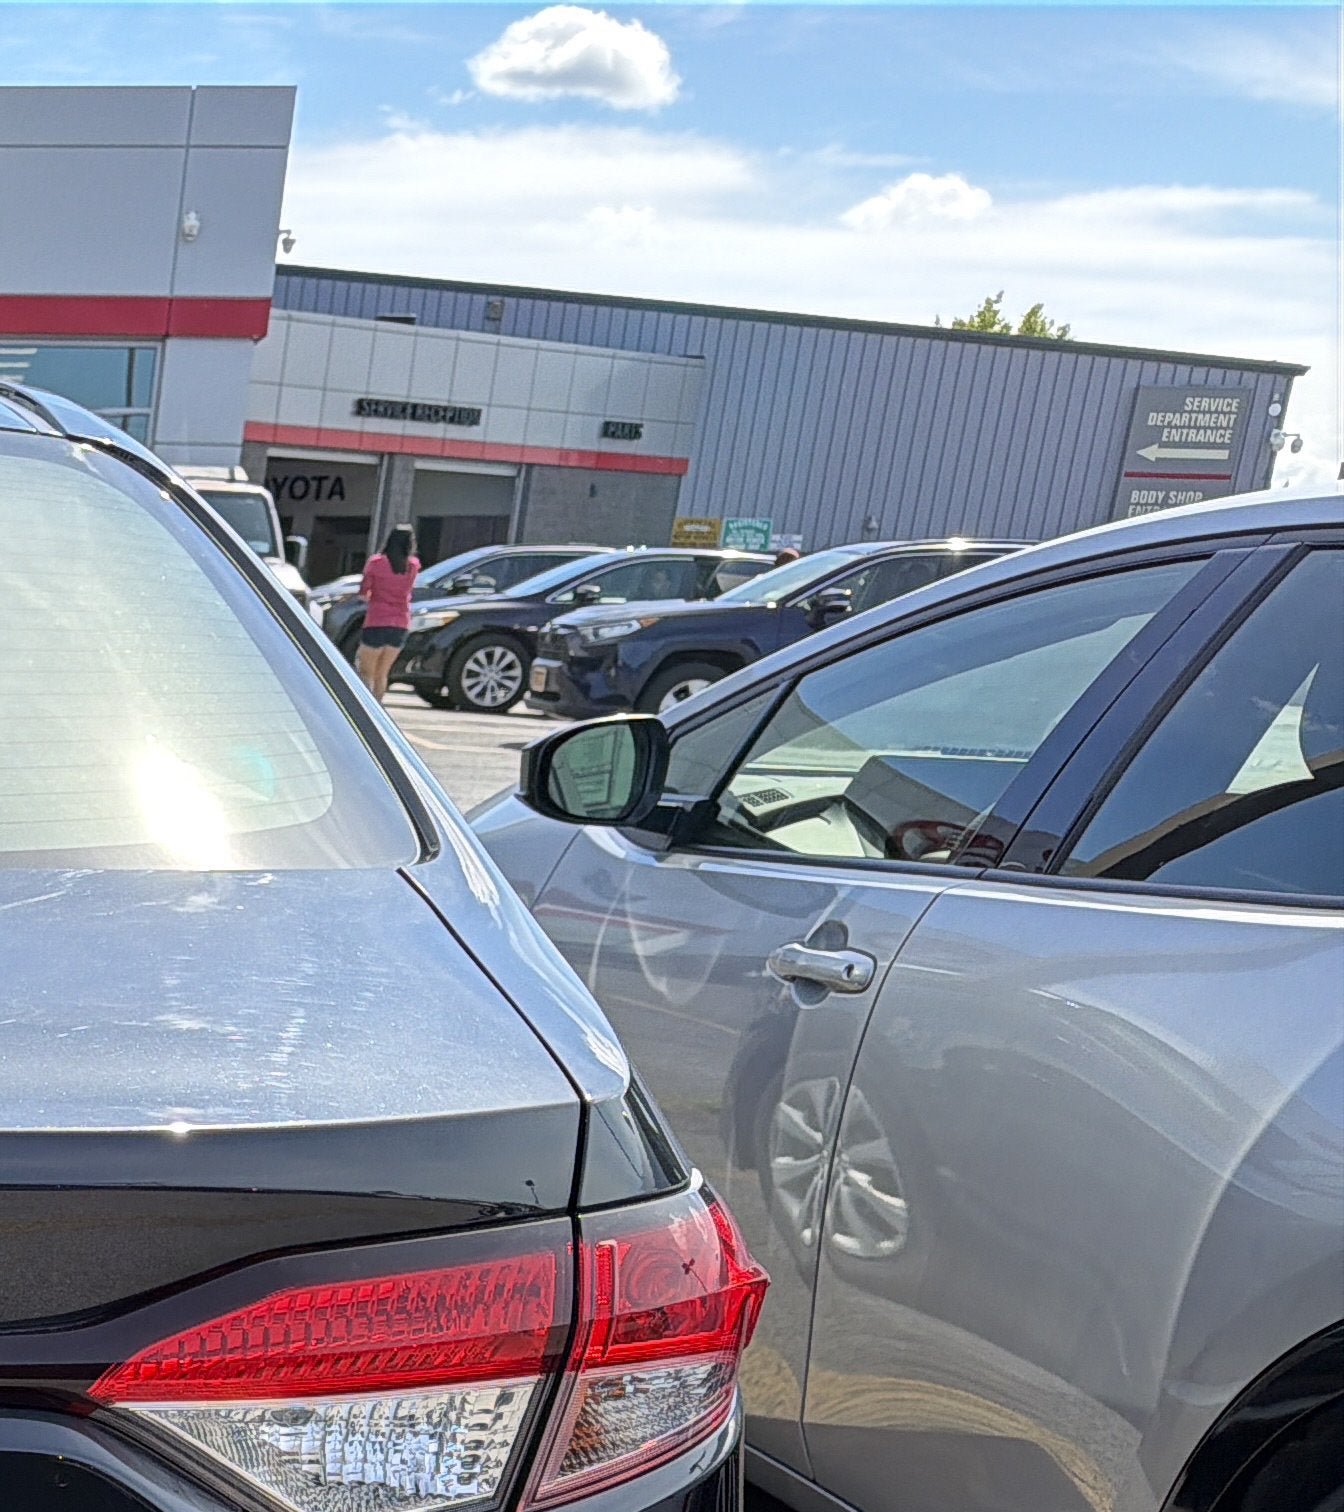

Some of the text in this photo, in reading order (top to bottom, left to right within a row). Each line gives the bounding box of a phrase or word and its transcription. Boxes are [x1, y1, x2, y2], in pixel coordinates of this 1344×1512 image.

[1184, 397, 1240, 412] SERVICE
[1148, 412, 1237, 428] DEPARTMENT
[1161, 428, 1233, 444] ENTRANCE
[1130, 490, 1203, 505] BODY SHOP
